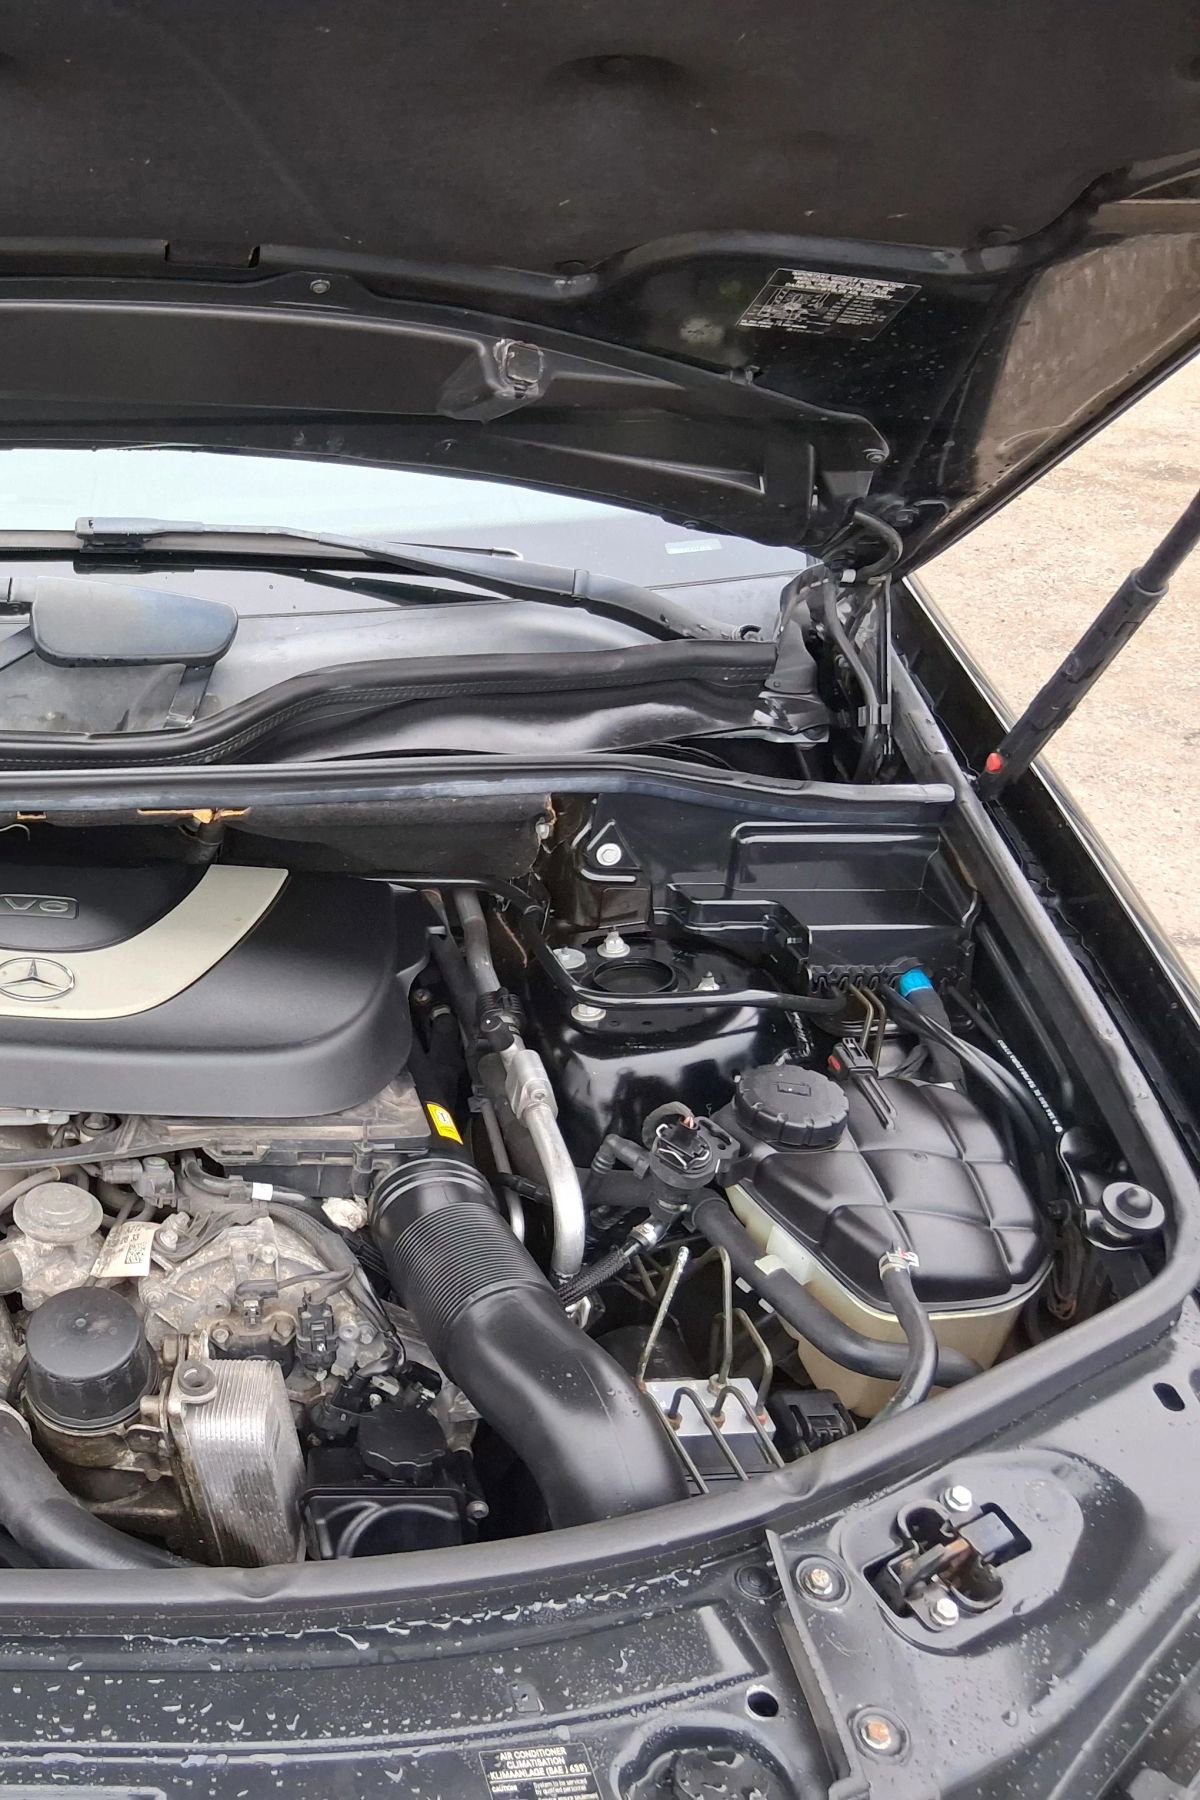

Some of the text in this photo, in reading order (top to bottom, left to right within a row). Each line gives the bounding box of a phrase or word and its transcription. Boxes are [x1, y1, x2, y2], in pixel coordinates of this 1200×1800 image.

[3, 897, 69, 912] V6
[500, 1747, 567, 1761] AIR CONDITIONER
[490, 1768, 546, 1780] KLIMAANLAGE
